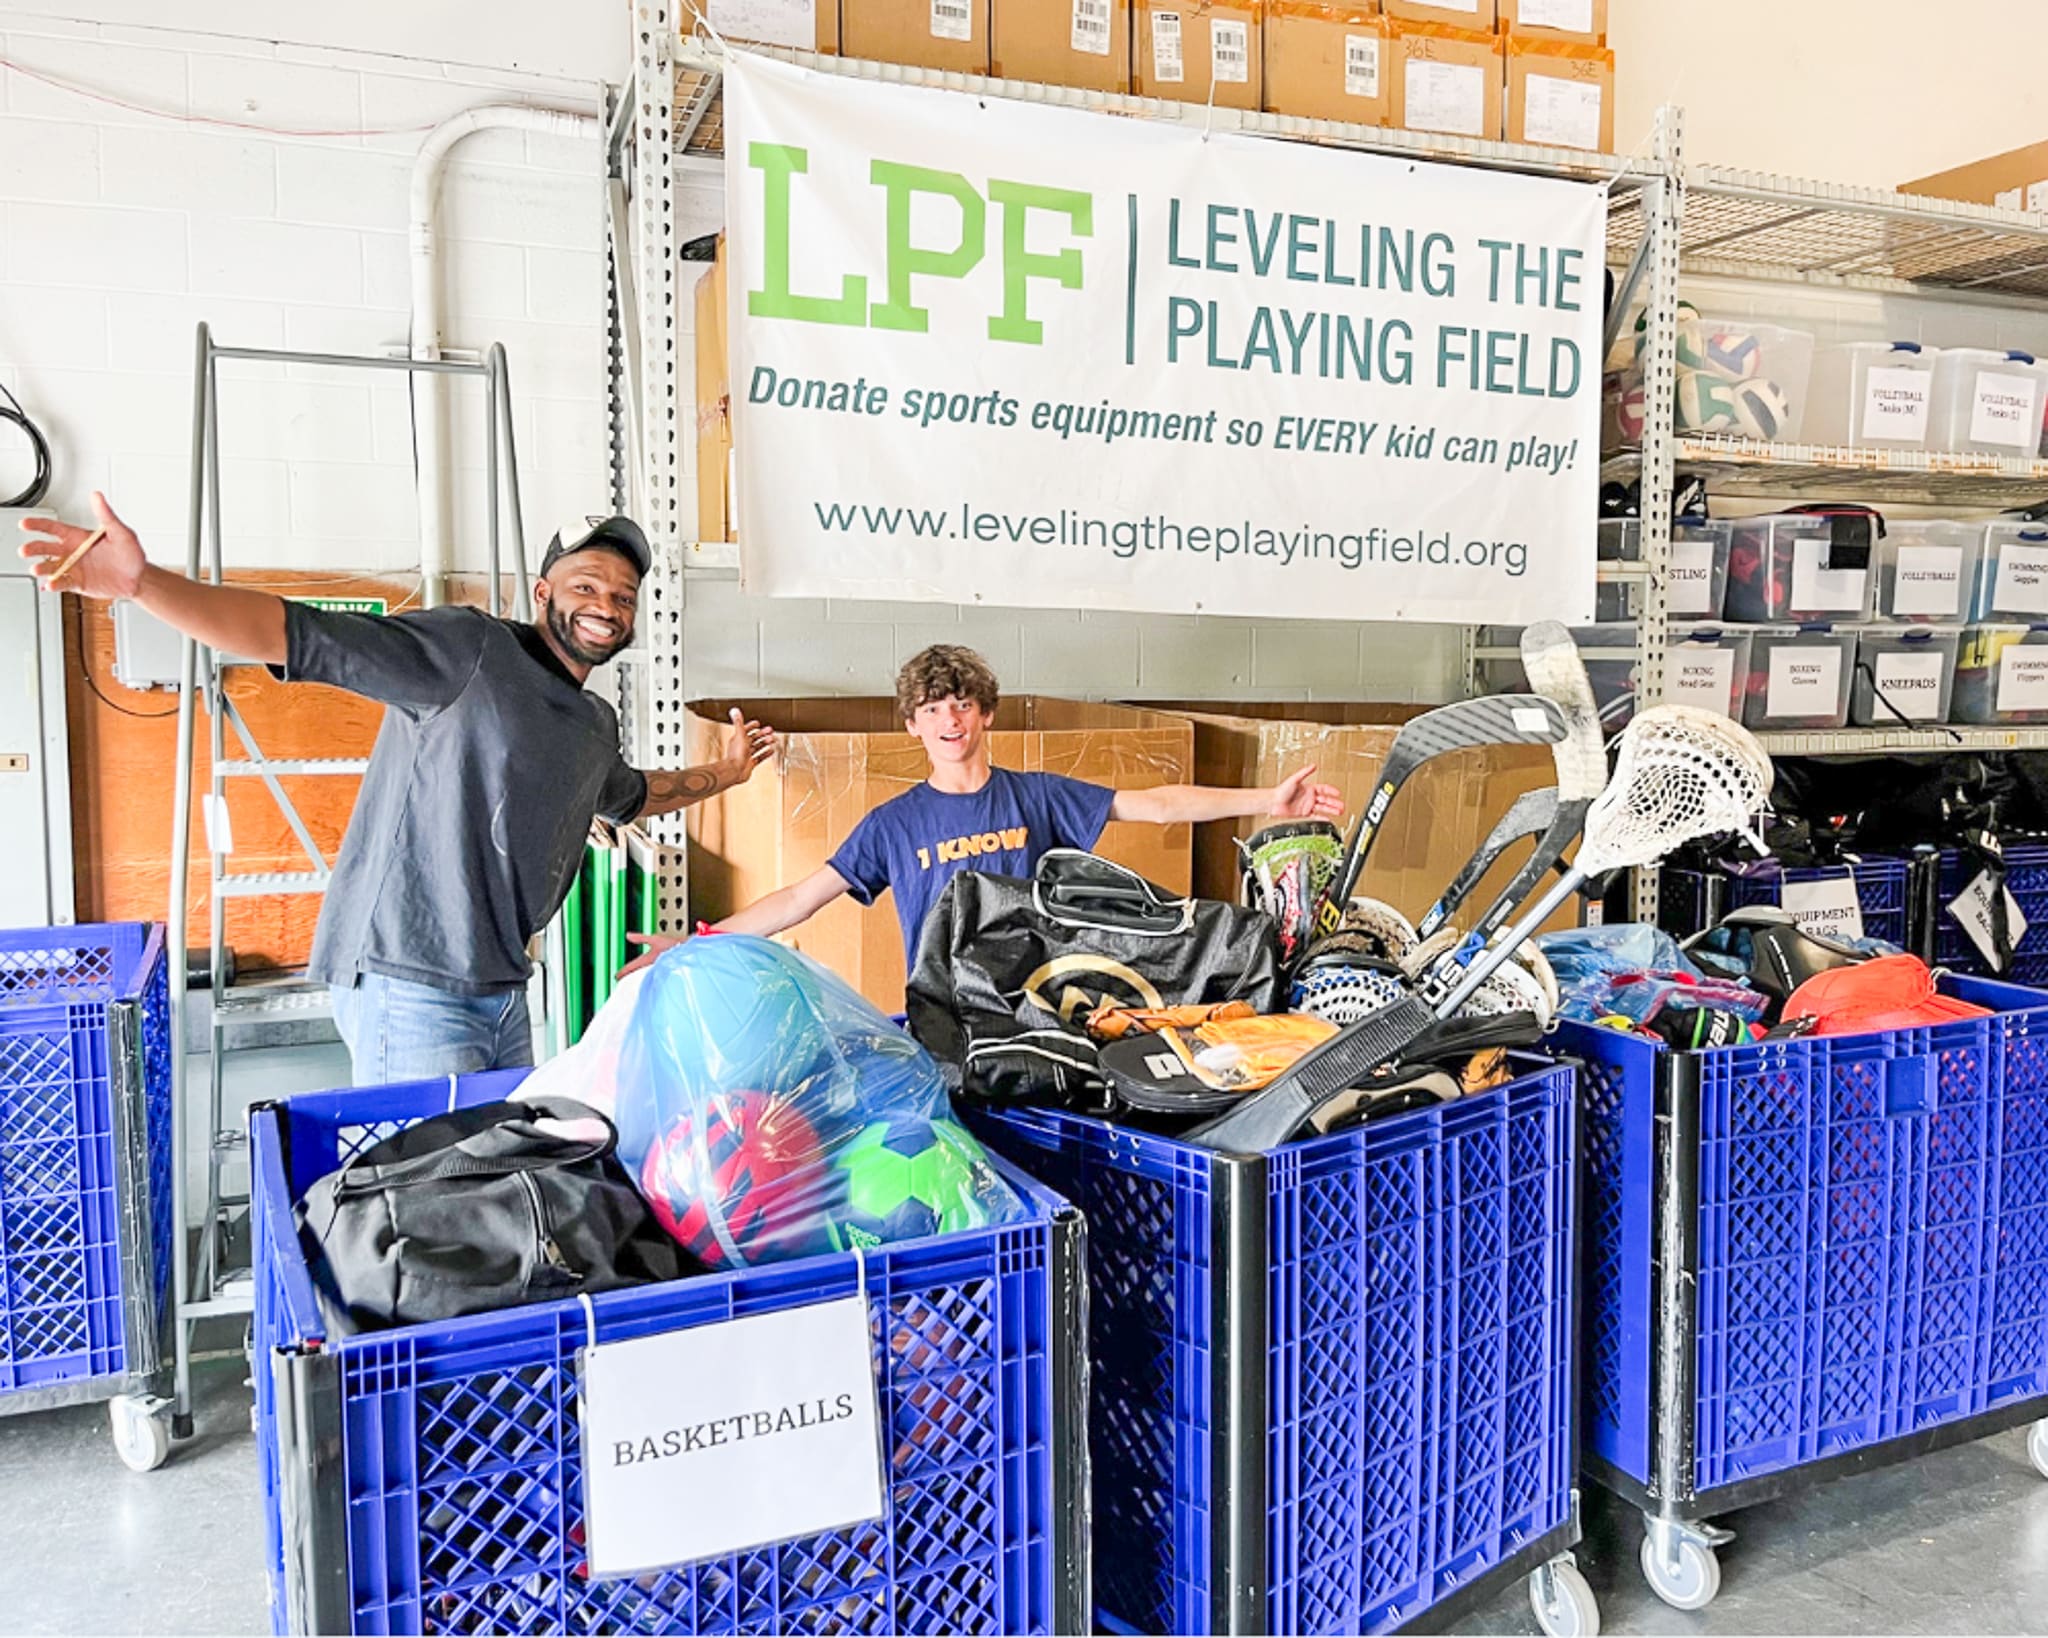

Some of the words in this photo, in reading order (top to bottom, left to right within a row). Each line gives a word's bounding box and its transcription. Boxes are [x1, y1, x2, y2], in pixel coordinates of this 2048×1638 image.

[747, 140, 1094, 346] LPF
[1167, 197, 1456, 299] LEVELING
[1478, 238, 1584, 313] THE
[1167, 295, 1414, 386] PLAYING
[1436, 325, 1583, 400] FIELD
[748, 365, 889, 416] Donate
[900, 389, 1020, 428] sports
[1030, 400, 1217, 444] equipment
[1225, 417, 1264, 447] so
[1273, 415, 1378, 456] EVERY
[1384, 424, 1435, 460] kid
[1442, 434, 1499, 465] can
[1504, 434, 1579, 477] play!
[814, 501, 1529, 577] www.levelingtheplayingfield.org
[1668, 568, 1708, 580] STLING
[1881, 677, 1937, 690] KNEEPADS
[936, 826, 1029, 865] KNOW
[1789, 906, 1855, 924] QUIPMENT
[1806, 924, 1839, 937] BAGS
[612, 1393, 854, 1467] BASKETBALLS
